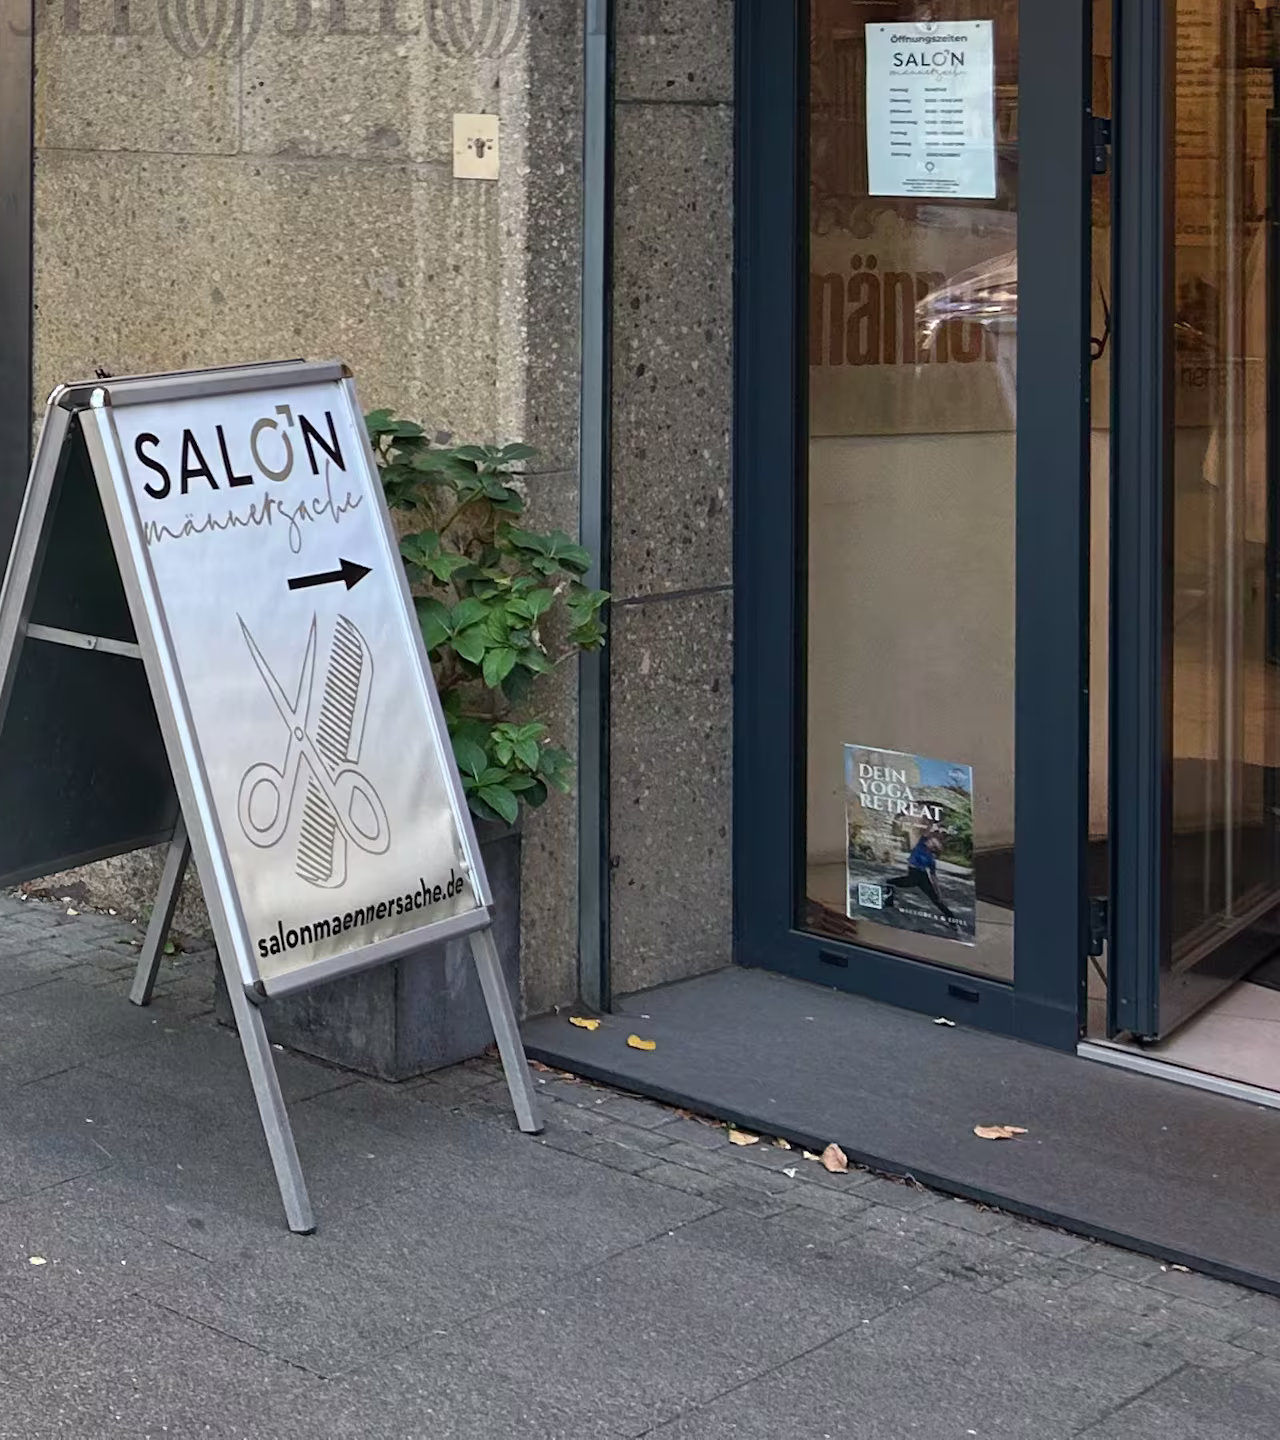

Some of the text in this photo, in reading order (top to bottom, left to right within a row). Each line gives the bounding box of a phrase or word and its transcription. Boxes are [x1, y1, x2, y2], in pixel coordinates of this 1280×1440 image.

[890, 34, 968, 45] Öffnungszeiten
[893, 49, 965, 67] SALON
[134, 404, 346, 500] SALON
[143, 458, 364, 554] männersache
[859, 763, 906, 784] DEIN
[859, 778, 914, 801] YOGA
[859, 792, 944, 821] RETREAT
[258, 868, 464, 958] salonmaennersache.de
